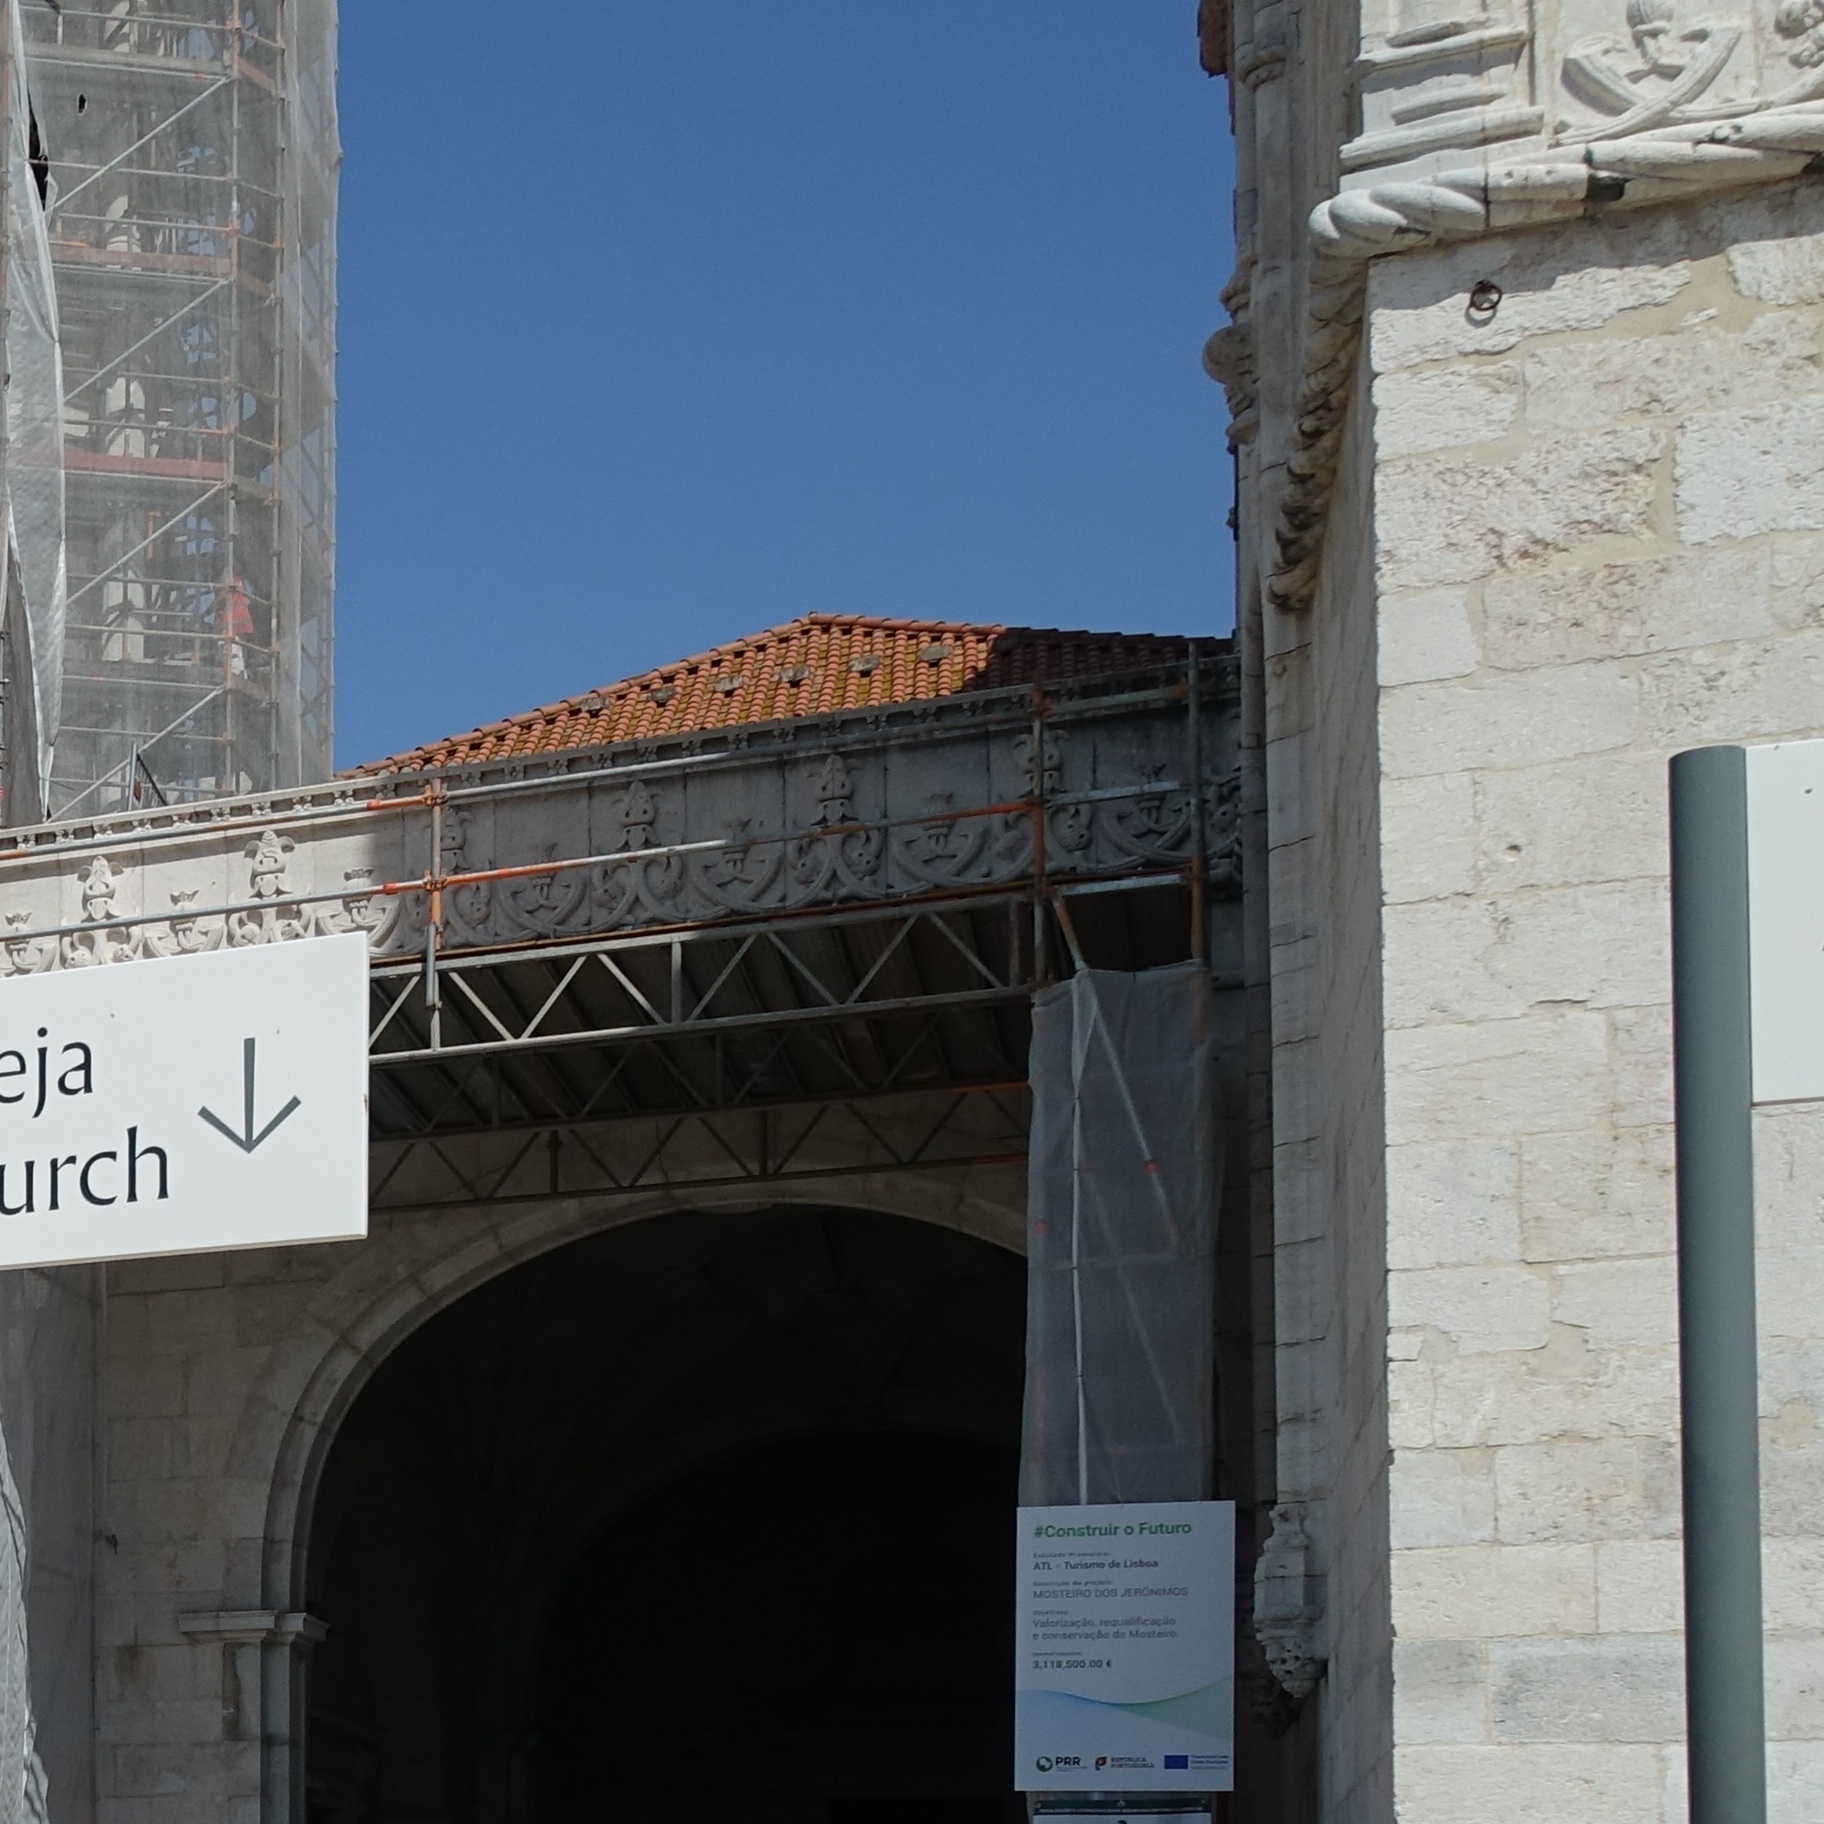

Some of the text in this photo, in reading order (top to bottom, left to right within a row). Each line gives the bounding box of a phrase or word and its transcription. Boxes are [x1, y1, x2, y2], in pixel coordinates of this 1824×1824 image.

[1034, 1522, 1192, 1538] #Construir o Futuro
[1033, 1562, 1053, 1571] ATL
[1108, 1560, 1121, 1568] de
[1123, 1558, 1159, 1568] Lisboa
[1055, 1756, 1081, 1767] PRR
